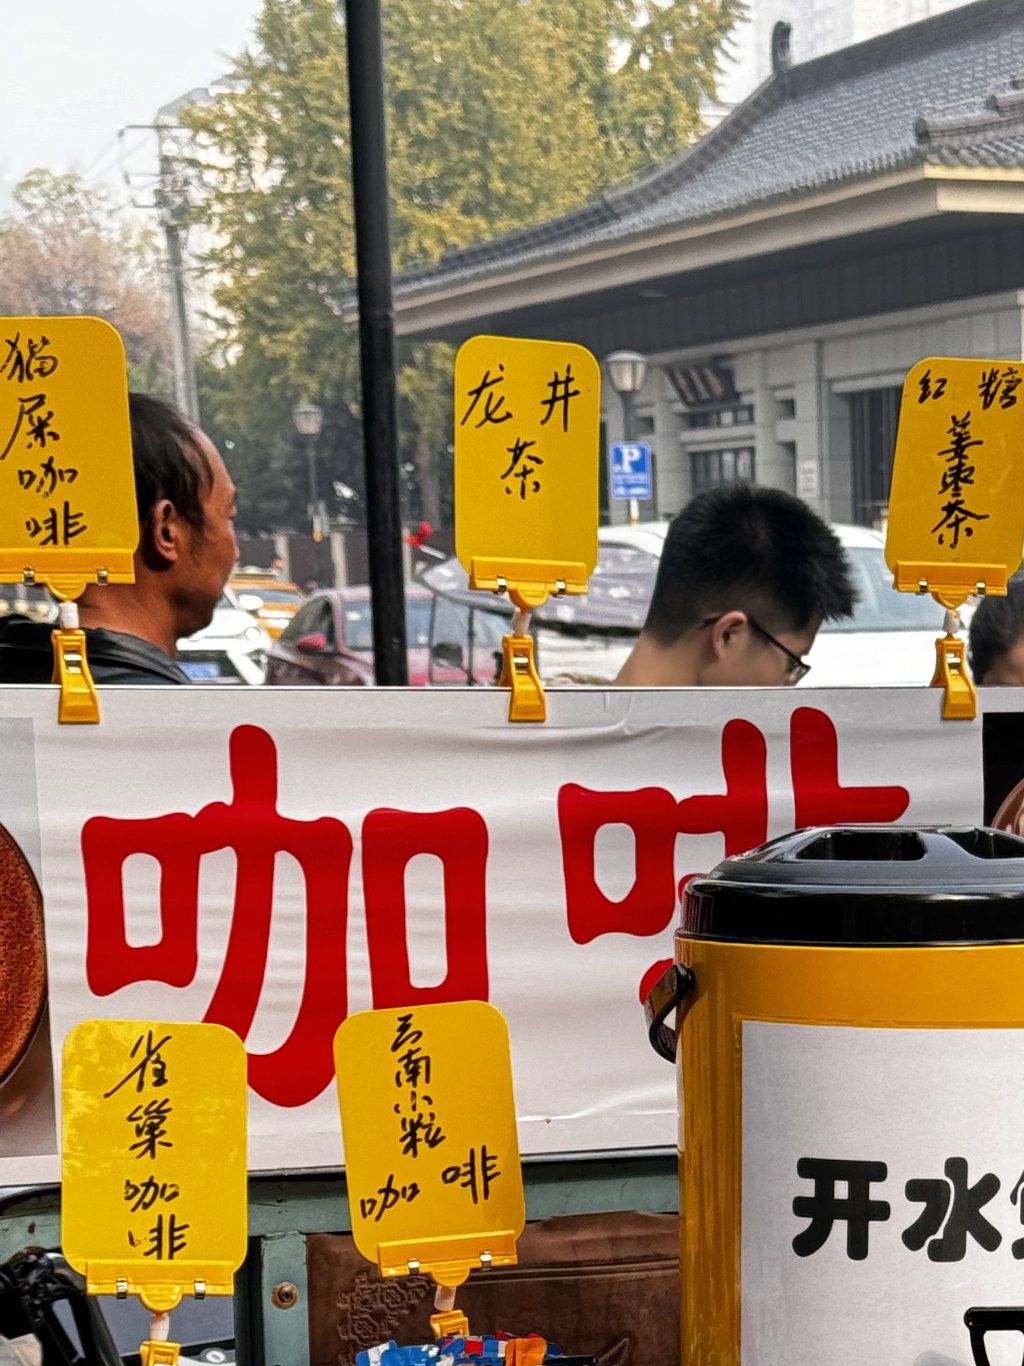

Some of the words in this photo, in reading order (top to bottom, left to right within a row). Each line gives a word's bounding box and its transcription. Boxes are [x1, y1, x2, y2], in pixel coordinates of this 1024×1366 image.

[460, 363, 580, 432] 龙井
[917, 367, 1023, 411] 红糖
[0, 332, 87, 546] 猫屎咖啡
[499, 437, 545, 500] 茶
[621, 447, 641, 474] P
[103, 1030, 190, 1260] 雀巢咖啡
[360, 1144, 501, 1222] 咖啡
